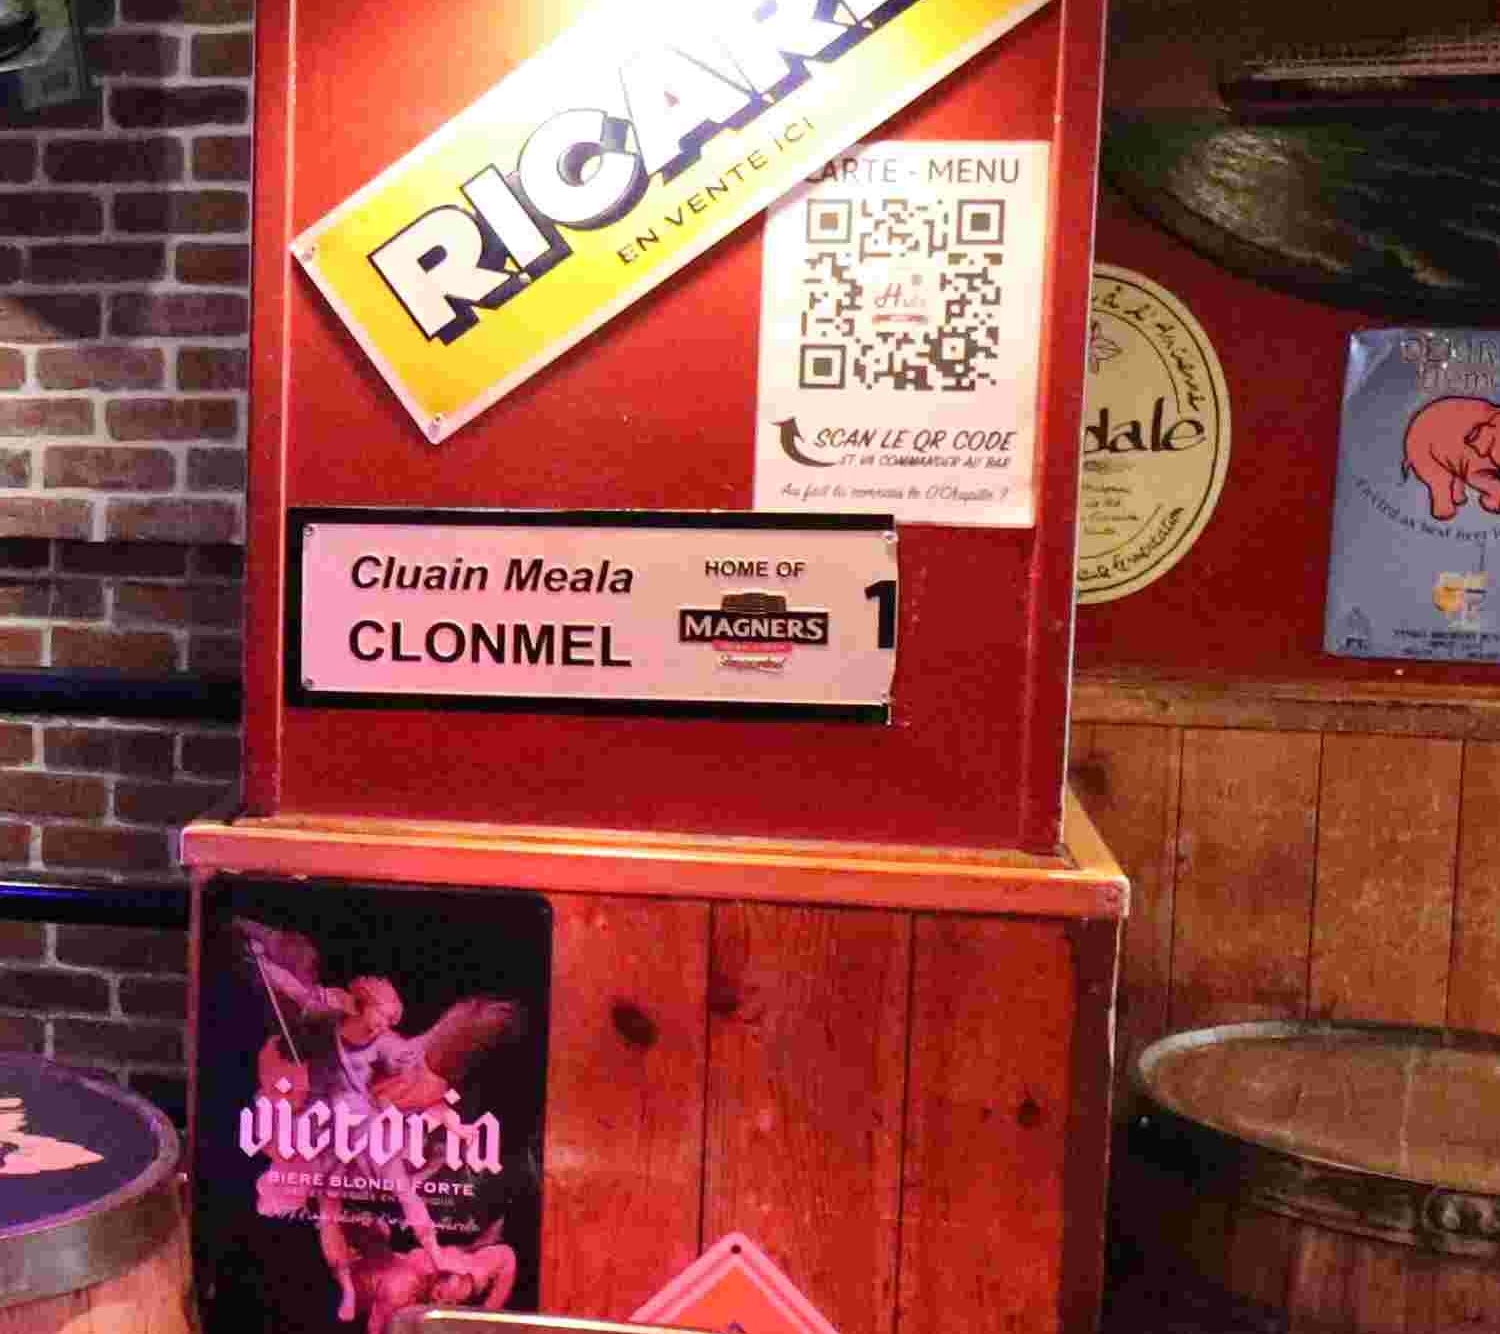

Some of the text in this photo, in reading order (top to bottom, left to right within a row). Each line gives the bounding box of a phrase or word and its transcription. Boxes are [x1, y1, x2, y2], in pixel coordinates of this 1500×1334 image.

[927, 157, 1020, 184] MENU
[615, 116, 816, 267] EN VENTE ICI
[813, 426, 1018, 453] SCAN LE QR CODE
[350, 554, 807, 594] Cluain Meala HOME OF
[348, 619, 634, 668] CLONMEL
[683, 614, 826, 641] MAGNERS
[239, 1076, 503, 1175] victoria
[415, 1180, 475, 1197] FORTE
